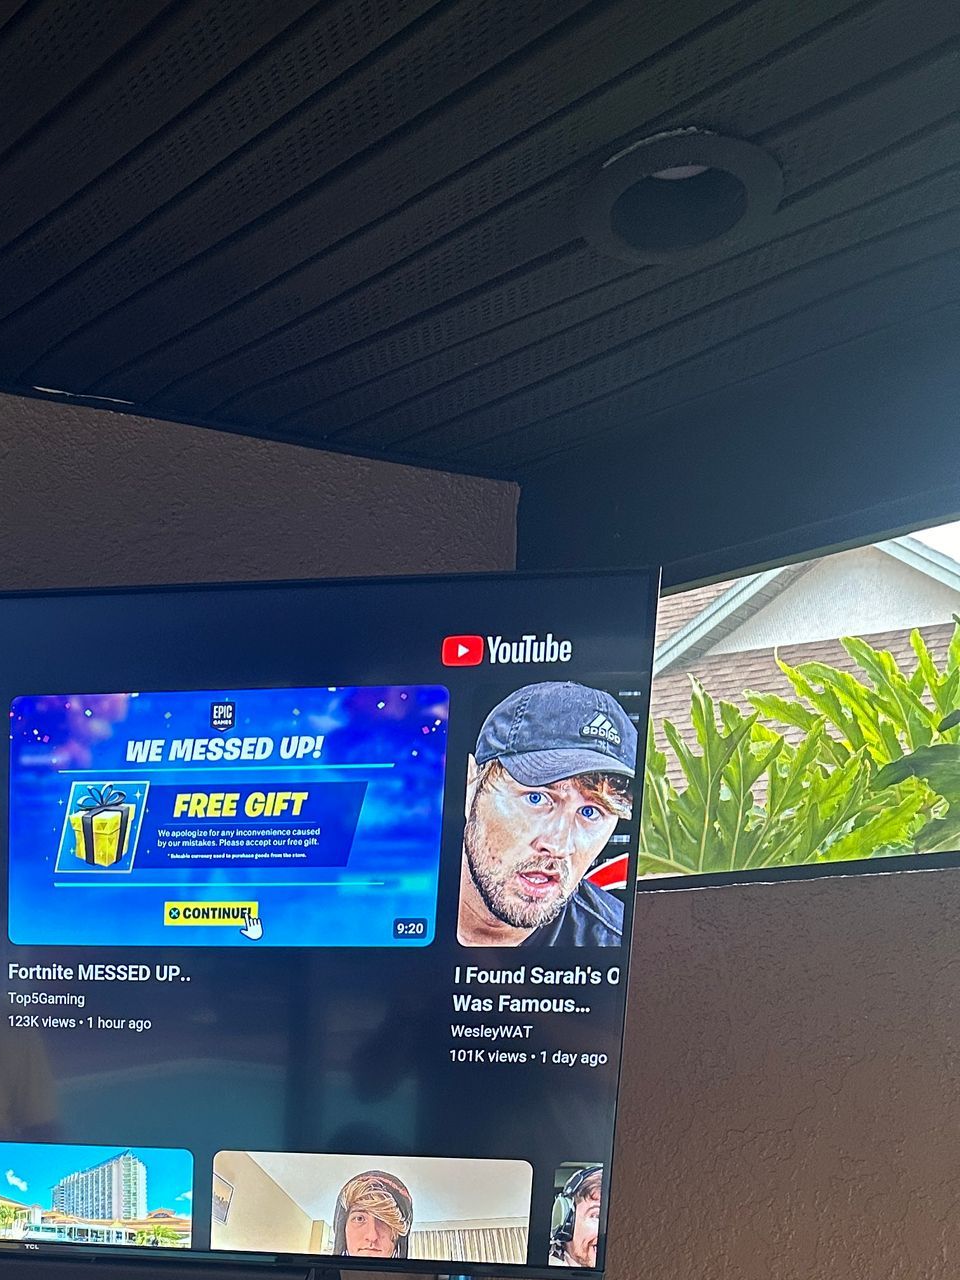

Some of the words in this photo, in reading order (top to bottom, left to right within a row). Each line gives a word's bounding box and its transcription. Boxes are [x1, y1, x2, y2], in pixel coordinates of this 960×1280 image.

[487, 634, 572, 664] YouTube
[213, 705, 232, 719] EPIC
[126, 740, 165, 762] WE
[168, 737, 274, 762] MESSED
[280, 736, 324, 759] UP!
[173, 793, 240, 818] FREE
[244, 792, 308, 817] GIFT
[158, 829, 170, 837] We
[171, 829, 208, 838] apologize
[220, 830, 235, 838] any
[236, 828, 290, 836] inconvenience
[292, 828, 320, 836] caused
[158, 839, 167, 848] by
[245, 839, 271, 847] accept
[287, 838, 302, 846] free
[304, 838, 319, 847] gift.
[396, 923, 424, 935] 9:20
[8, 963, 74, 980] Fortnite
[78, 964, 151, 981] MESSED
[155, 965, 191, 982] UP..
[454, 966, 460, 984] I
[466, 966, 526, 984] Found
[530, 966, 602, 985] Sarah's
[8, 992, 86, 1008] Top5Gaming
[452, 994, 493, 1012] Was
[498, 995, 591, 1013] Famous...
[8, 1016, 39, 1027] 123K
[42, 1016, 76, 1028] views
[87, 1017, 93, 1028] 1
[98, 1017, 125, 1029] hour
[128, 1020, 152, 1032] ago
[451, 1024, 533, 1040] WesleyWAT
[450, 1050, 484, 1062] 101K
[488, 1050, 527, 1062] views
[540, 1051, 547, 1063] 1
[552, 1050, 578, 1067] day
[580, 1055, 608, 1067] ago
